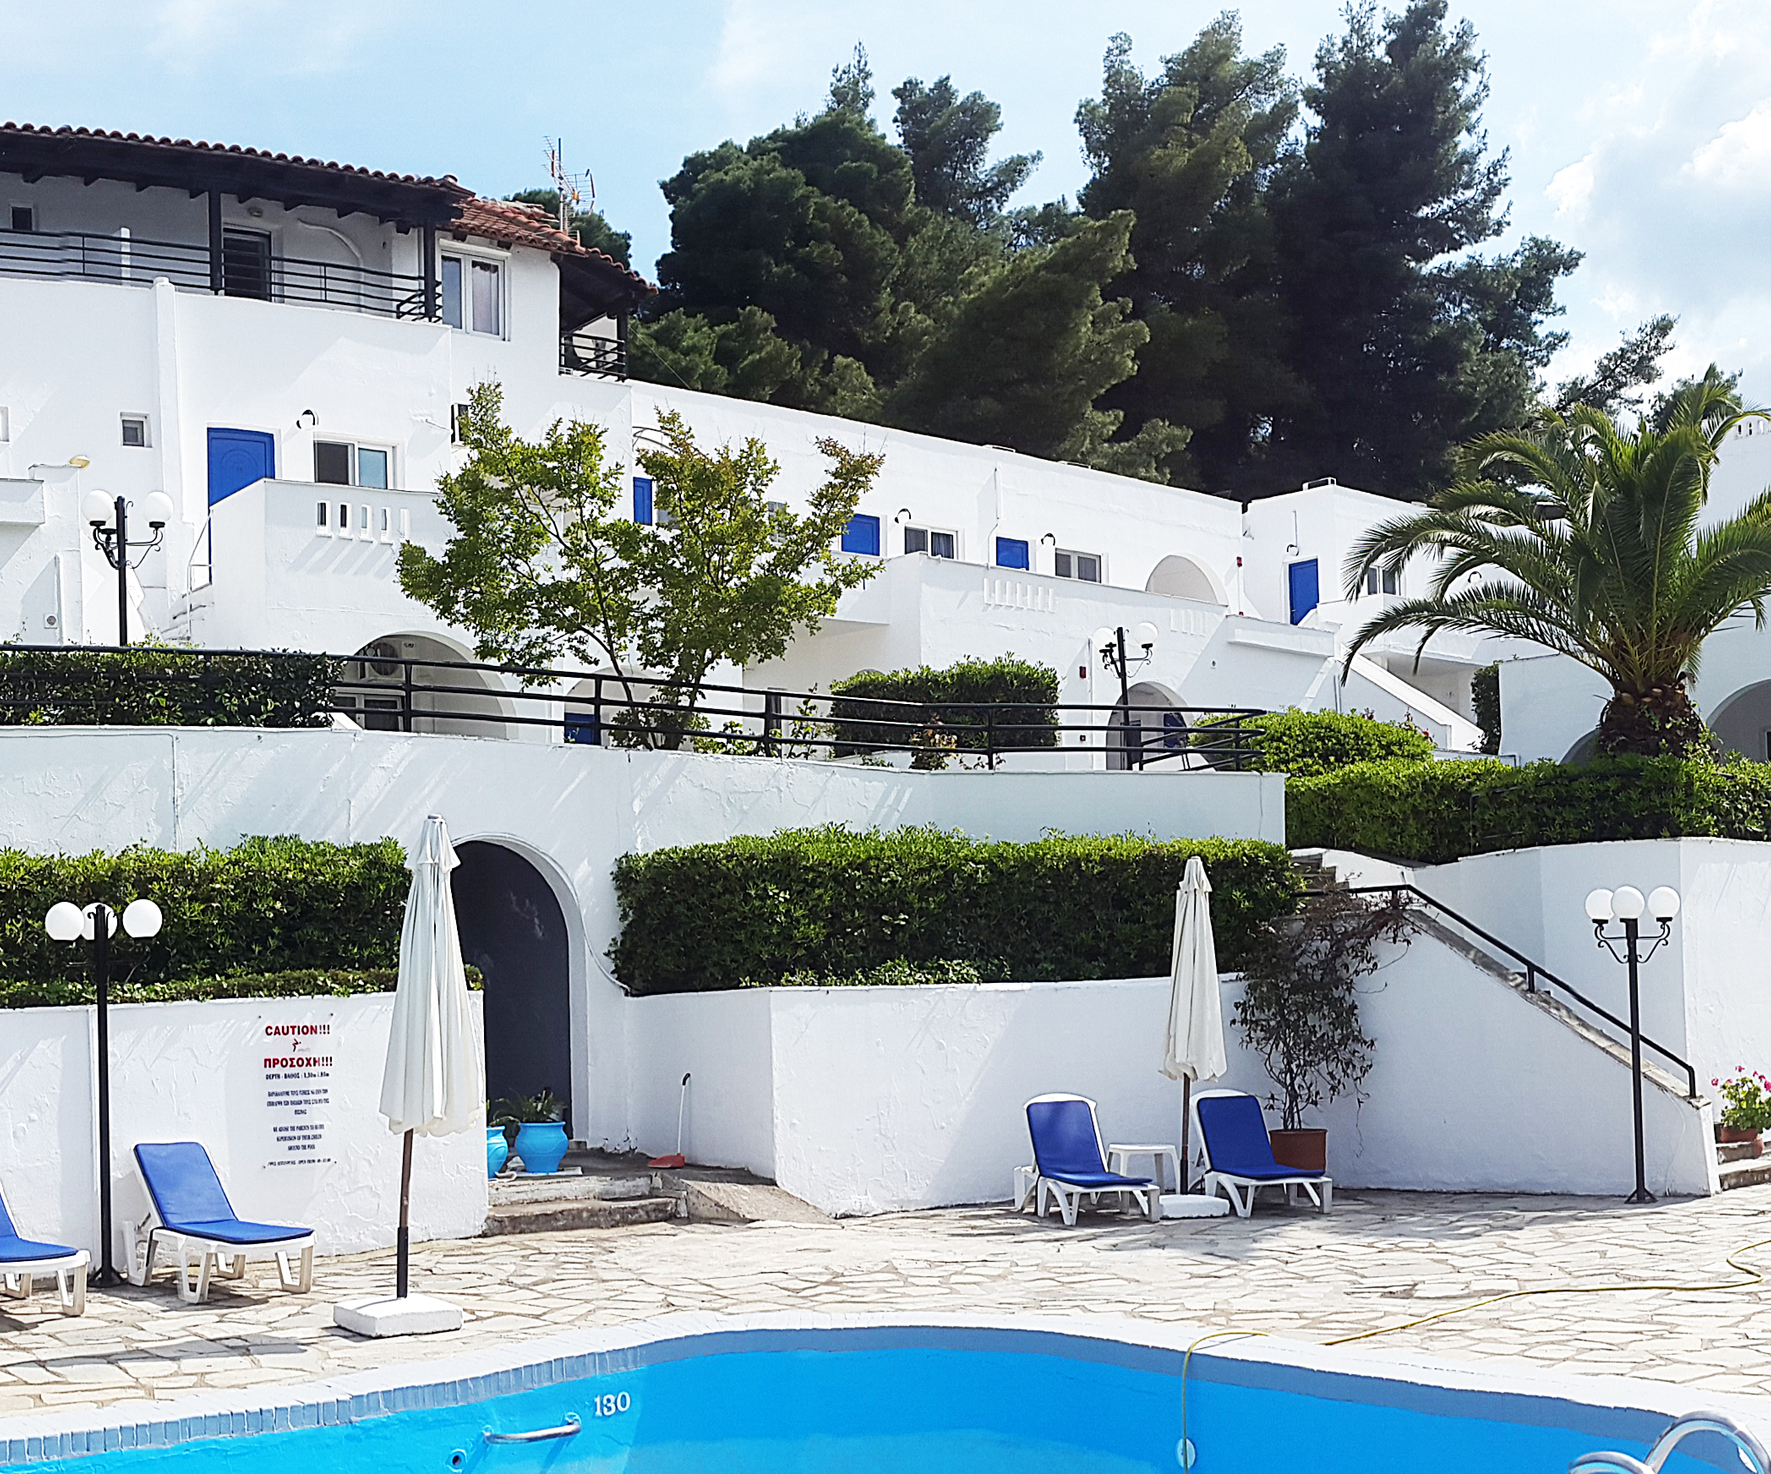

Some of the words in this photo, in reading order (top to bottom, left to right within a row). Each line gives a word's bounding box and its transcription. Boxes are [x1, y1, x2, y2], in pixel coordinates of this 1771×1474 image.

[265, 1024, 330, 1036] CAUTION!!!
[263, 1056, 333, 1069] ΠΡΟΣΟΧΗ!!!
[594, 1391, 631, 1417] 130
